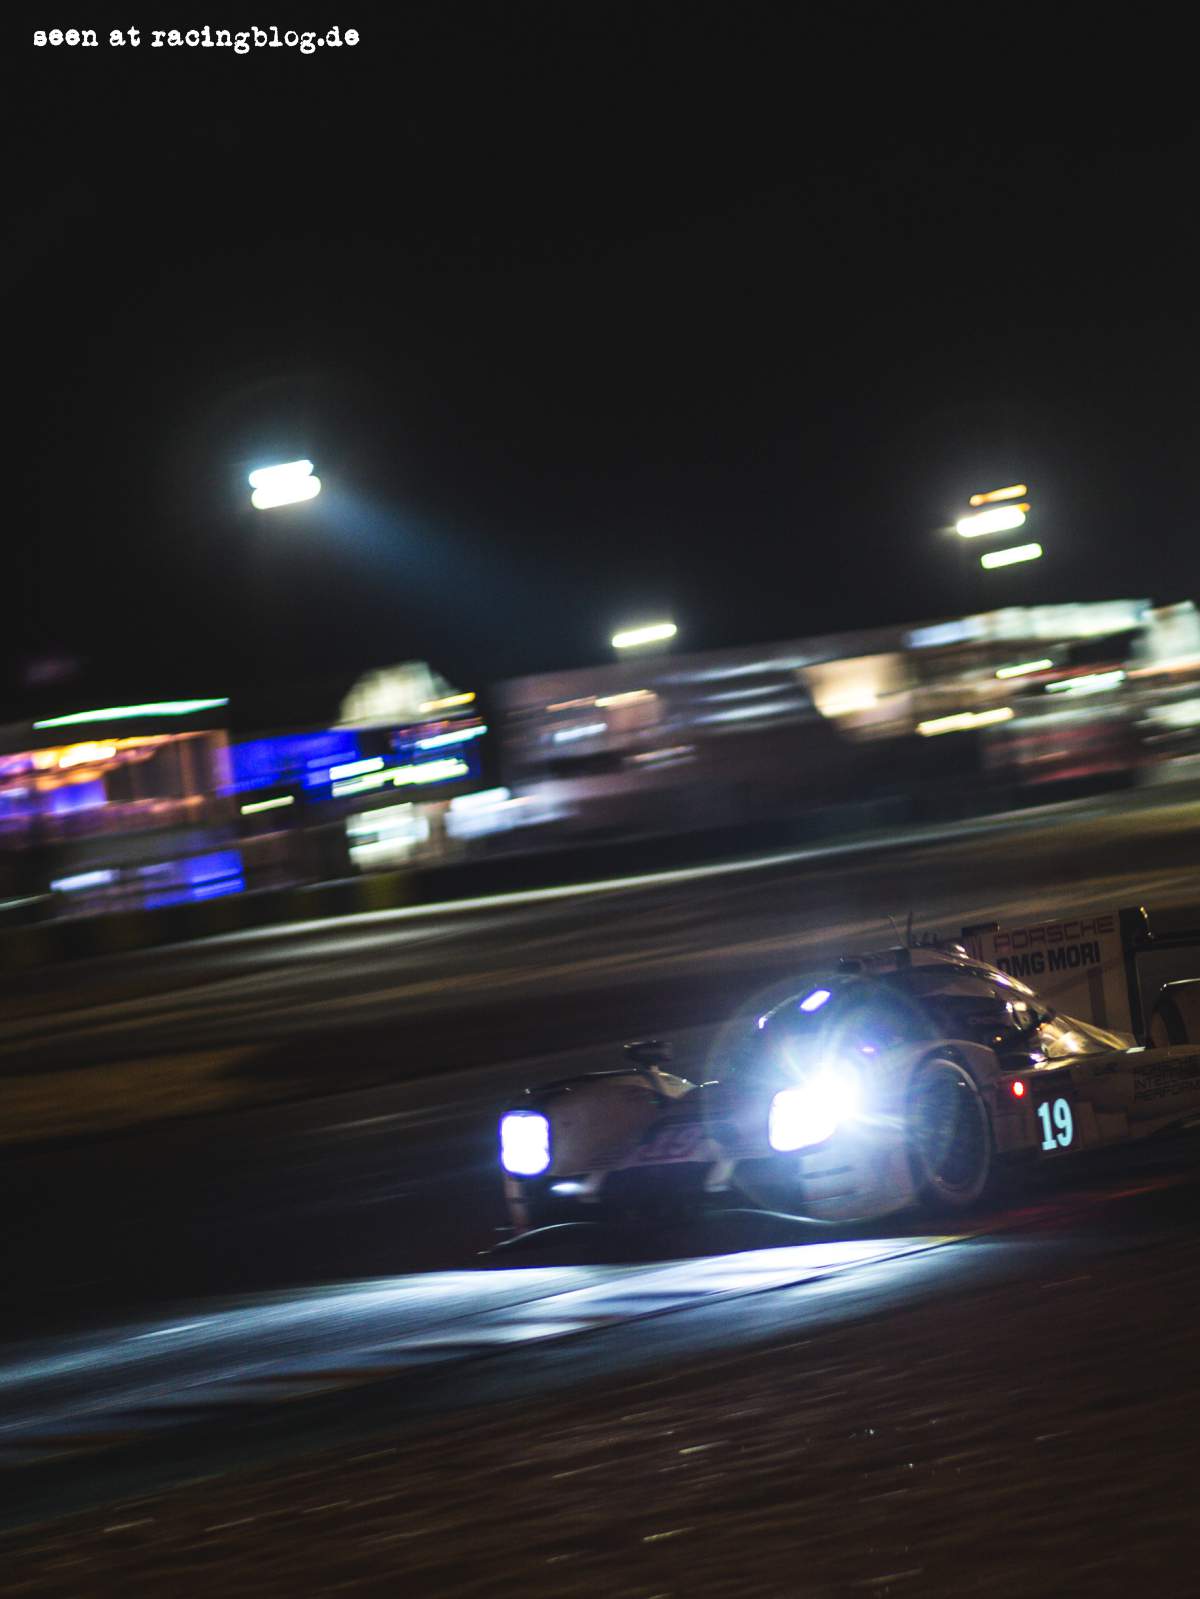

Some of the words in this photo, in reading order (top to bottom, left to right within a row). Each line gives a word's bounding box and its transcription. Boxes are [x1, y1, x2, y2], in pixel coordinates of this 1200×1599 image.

[993, 915, 1115, 953] PORSCHE
[1047, 941, 1101, 972] MORI
[1037, 1098, 1073, 1151] 19
